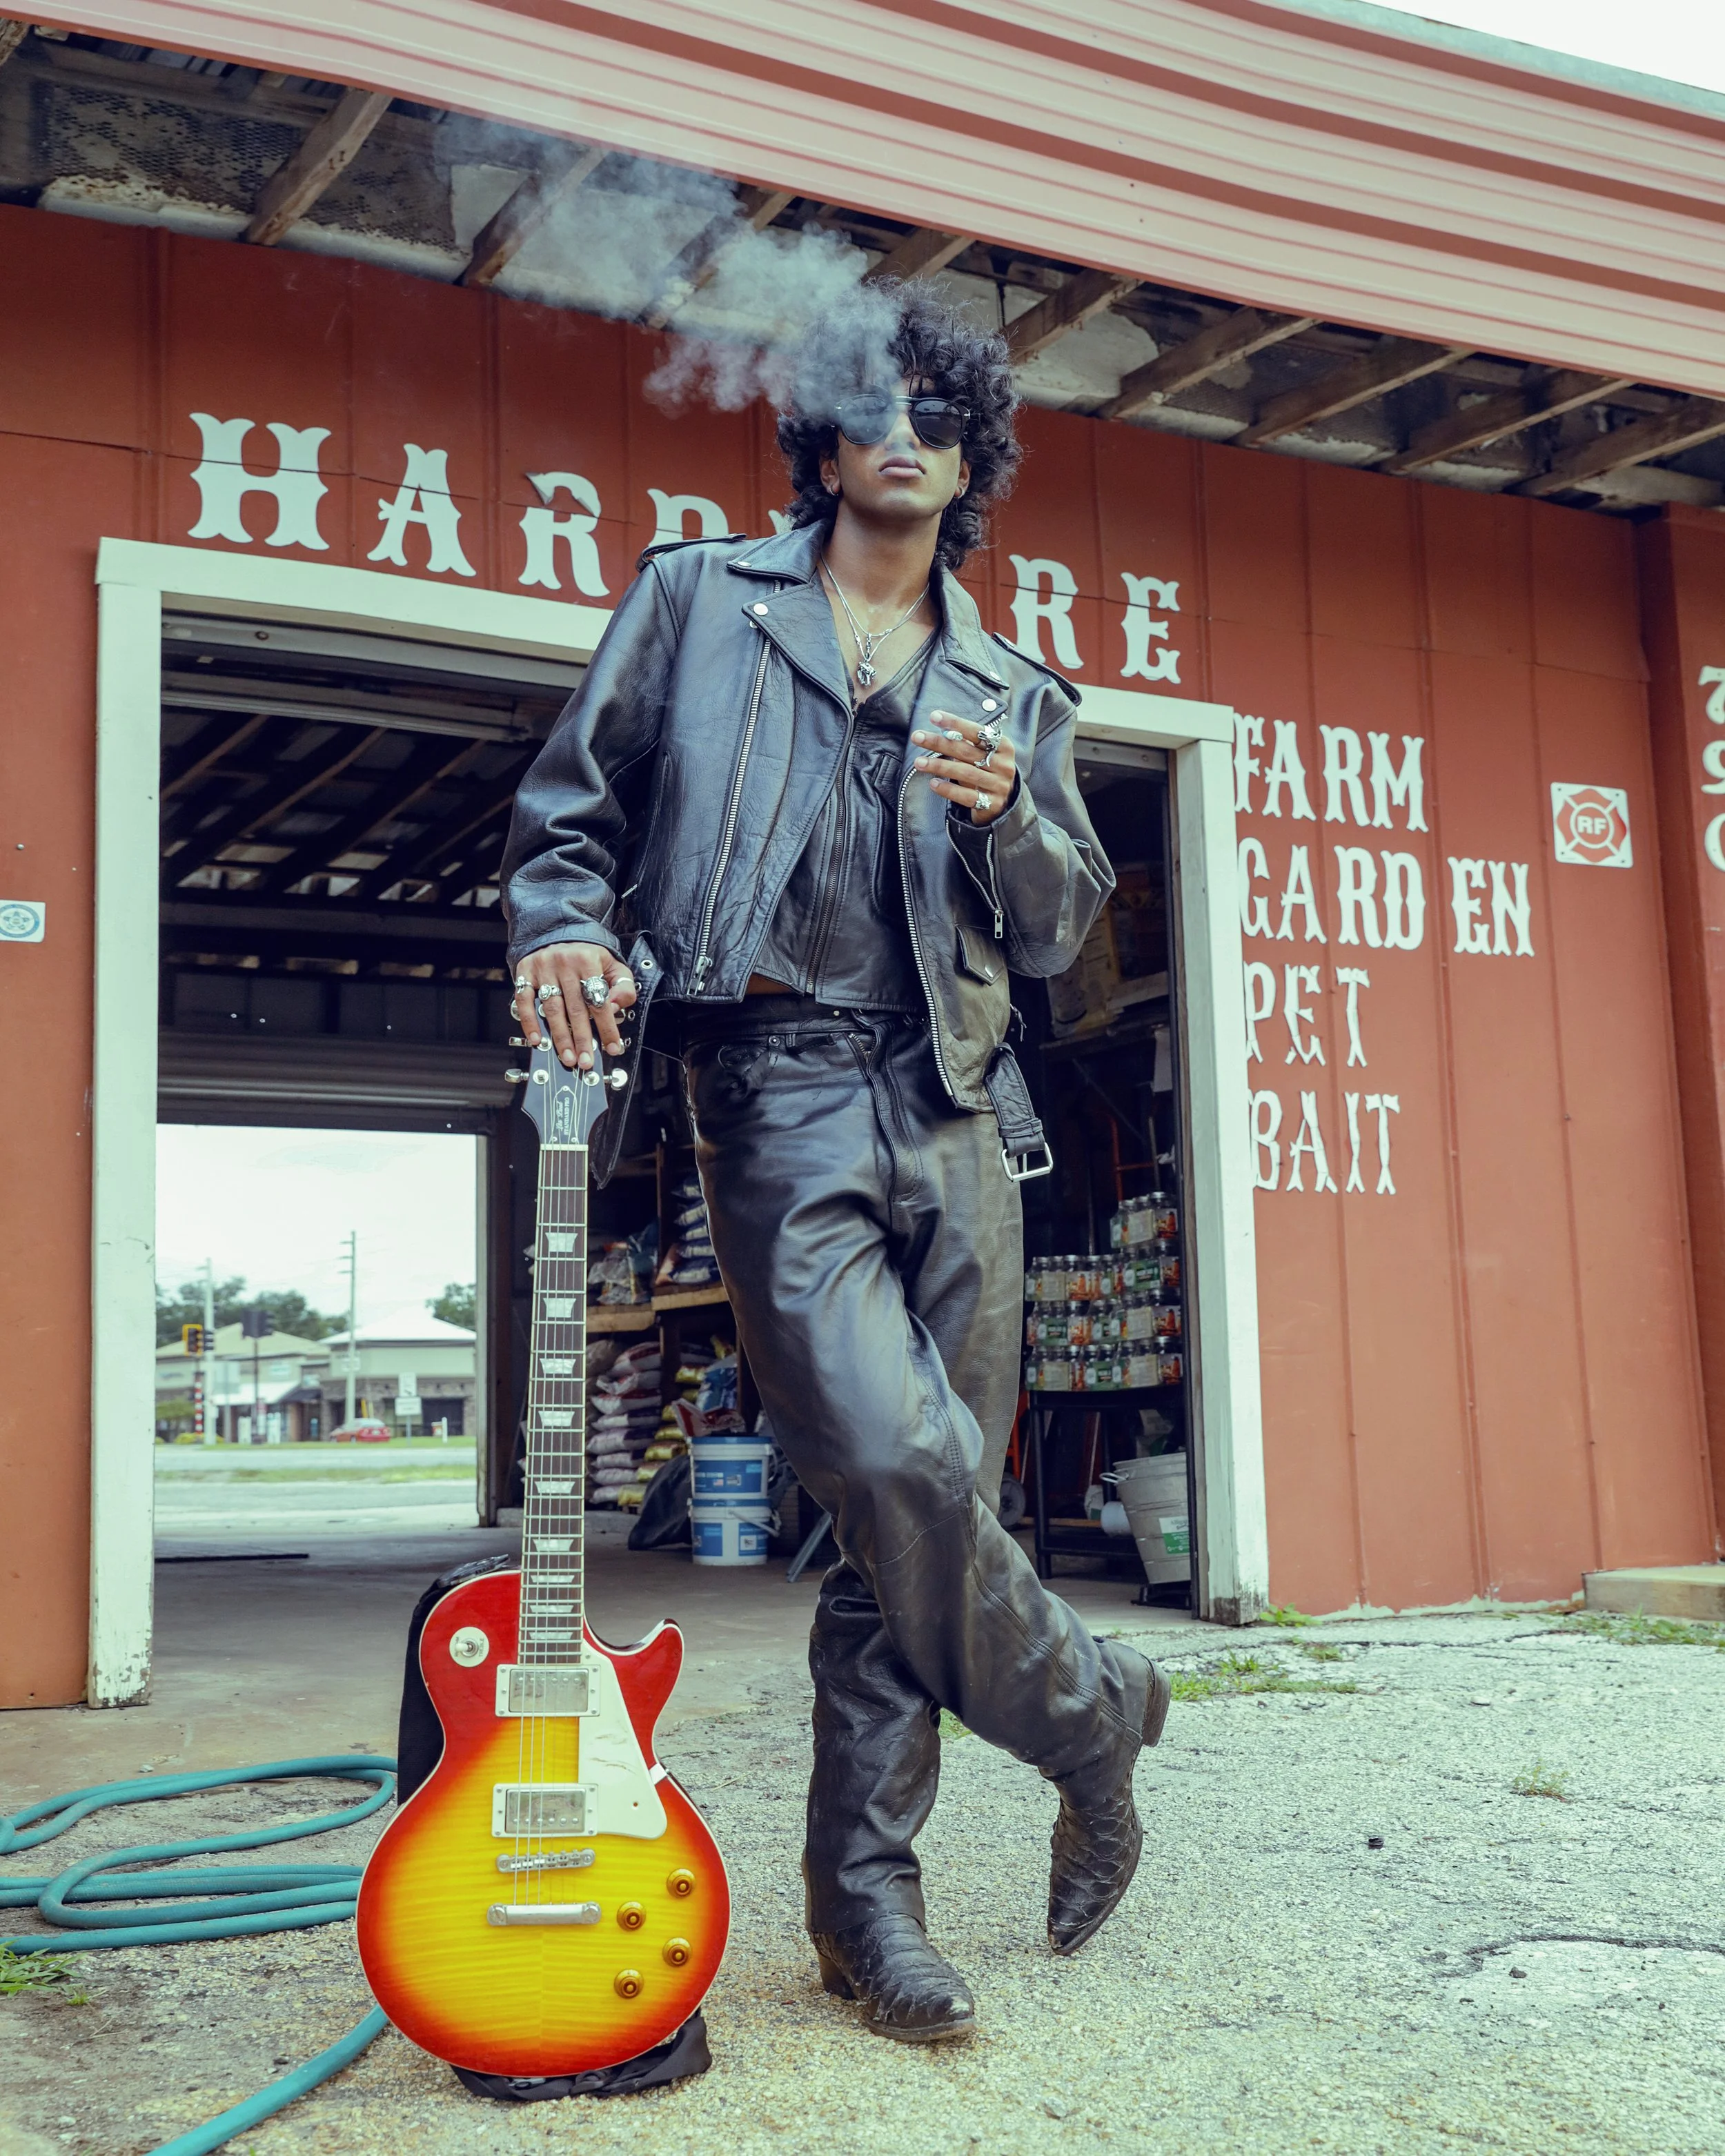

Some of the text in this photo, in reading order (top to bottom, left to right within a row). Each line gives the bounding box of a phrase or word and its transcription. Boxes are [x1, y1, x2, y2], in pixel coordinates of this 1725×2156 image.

[1233, 713, 1429, 832] FARM
[1577, 815, 1607, 835] RF
[1243, 961, 1370, 1068] PET
[1248, 1088, 1400, 1195] BAIT
